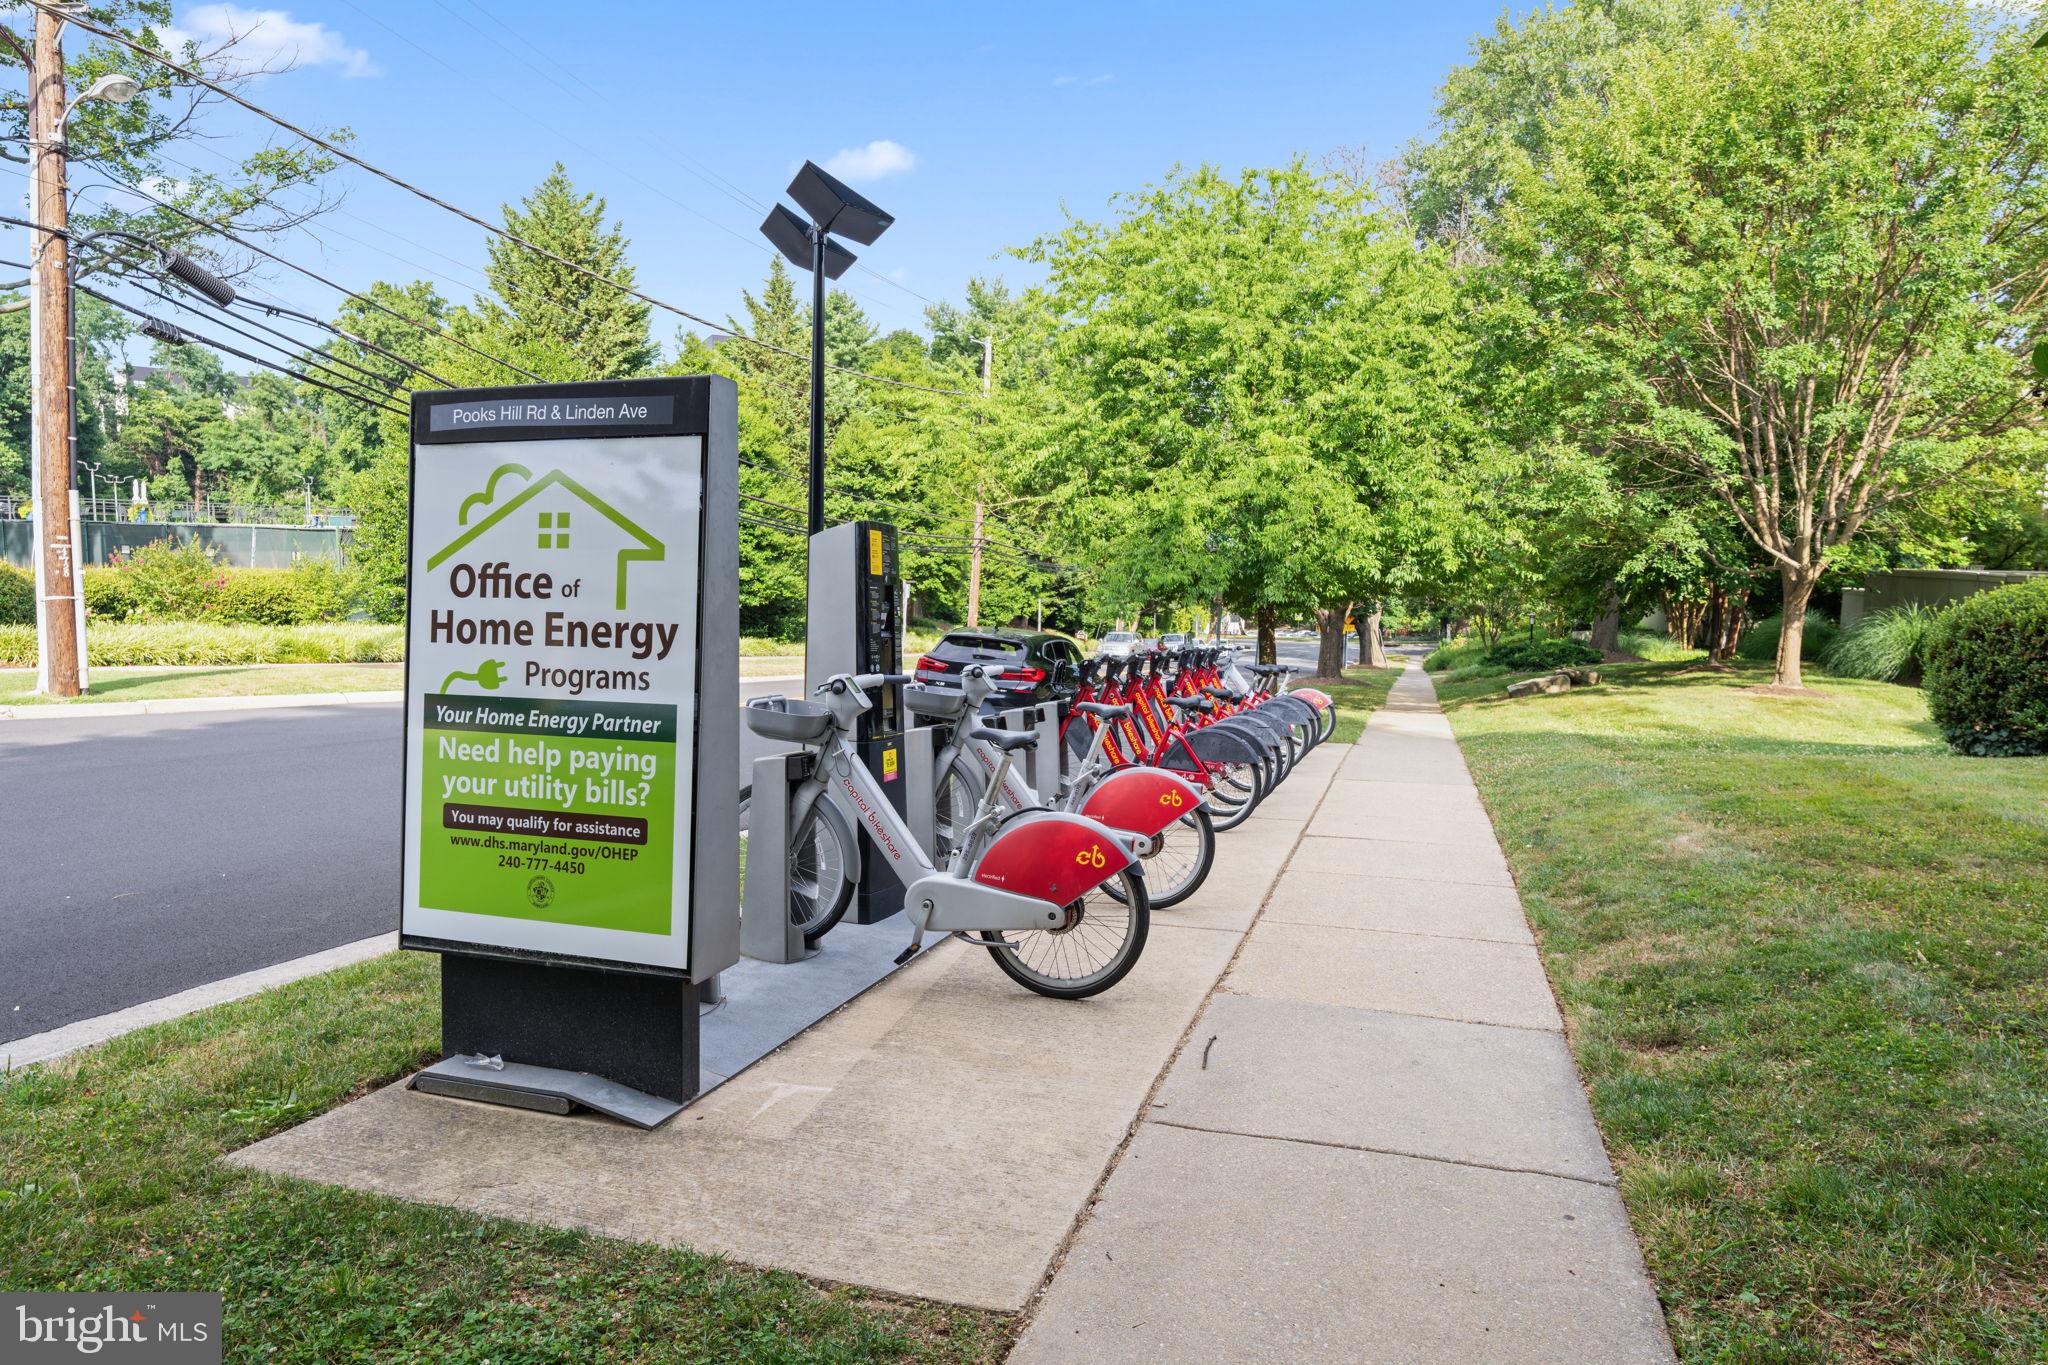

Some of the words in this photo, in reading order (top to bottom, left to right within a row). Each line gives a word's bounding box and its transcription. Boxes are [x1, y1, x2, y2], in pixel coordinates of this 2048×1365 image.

[453, 406, 496, 424] Pooks
[500, 405, 522, 421] Hill
[526, 404, 547, 421] Rd
[551, 405, 562, 420] &
[566, 403, 615, 420] Linden
[619, 403, 648, 419] Ave
[449, 562, 553, 599] Office
[561, 579, 581, 598] of
[430, 609, 534, 646] Home
[545, 611, 679, 661] Energy
[525, 660, 650, 695] Programs
[436, 705, 473, 724] Your
[476, 707, 523, 727] Home
[528, 710, 588, 734] Energy
[592, 712, 661, 734] Partner
[1135, 692, 1150, 714] capital
[1124, 722, 1142, 755] bikeshare
[439, 736, 500, 763] Need
[508, 738, 561, 774] help
[569, 746, 657, 780] paying
[442, 774, 497, 798] your
[504, 774, 578, 808] utility
[586, 779, 651, 806] bills?
[451, 809, 475, 824] You
[478, 815, 504, 829] may
[506, 816, 550, 834] qualify
[553, 817, 572, 832] for
[575, 822, 641, 838] assistance
[843, 778, 871, 813] capital
[868, 811, 901, 861] bikeshare
[450, 835, 639, 861] www.dhs.maryland.gov/OHEP
[498, 854, 585, 875] 240-777-4450
